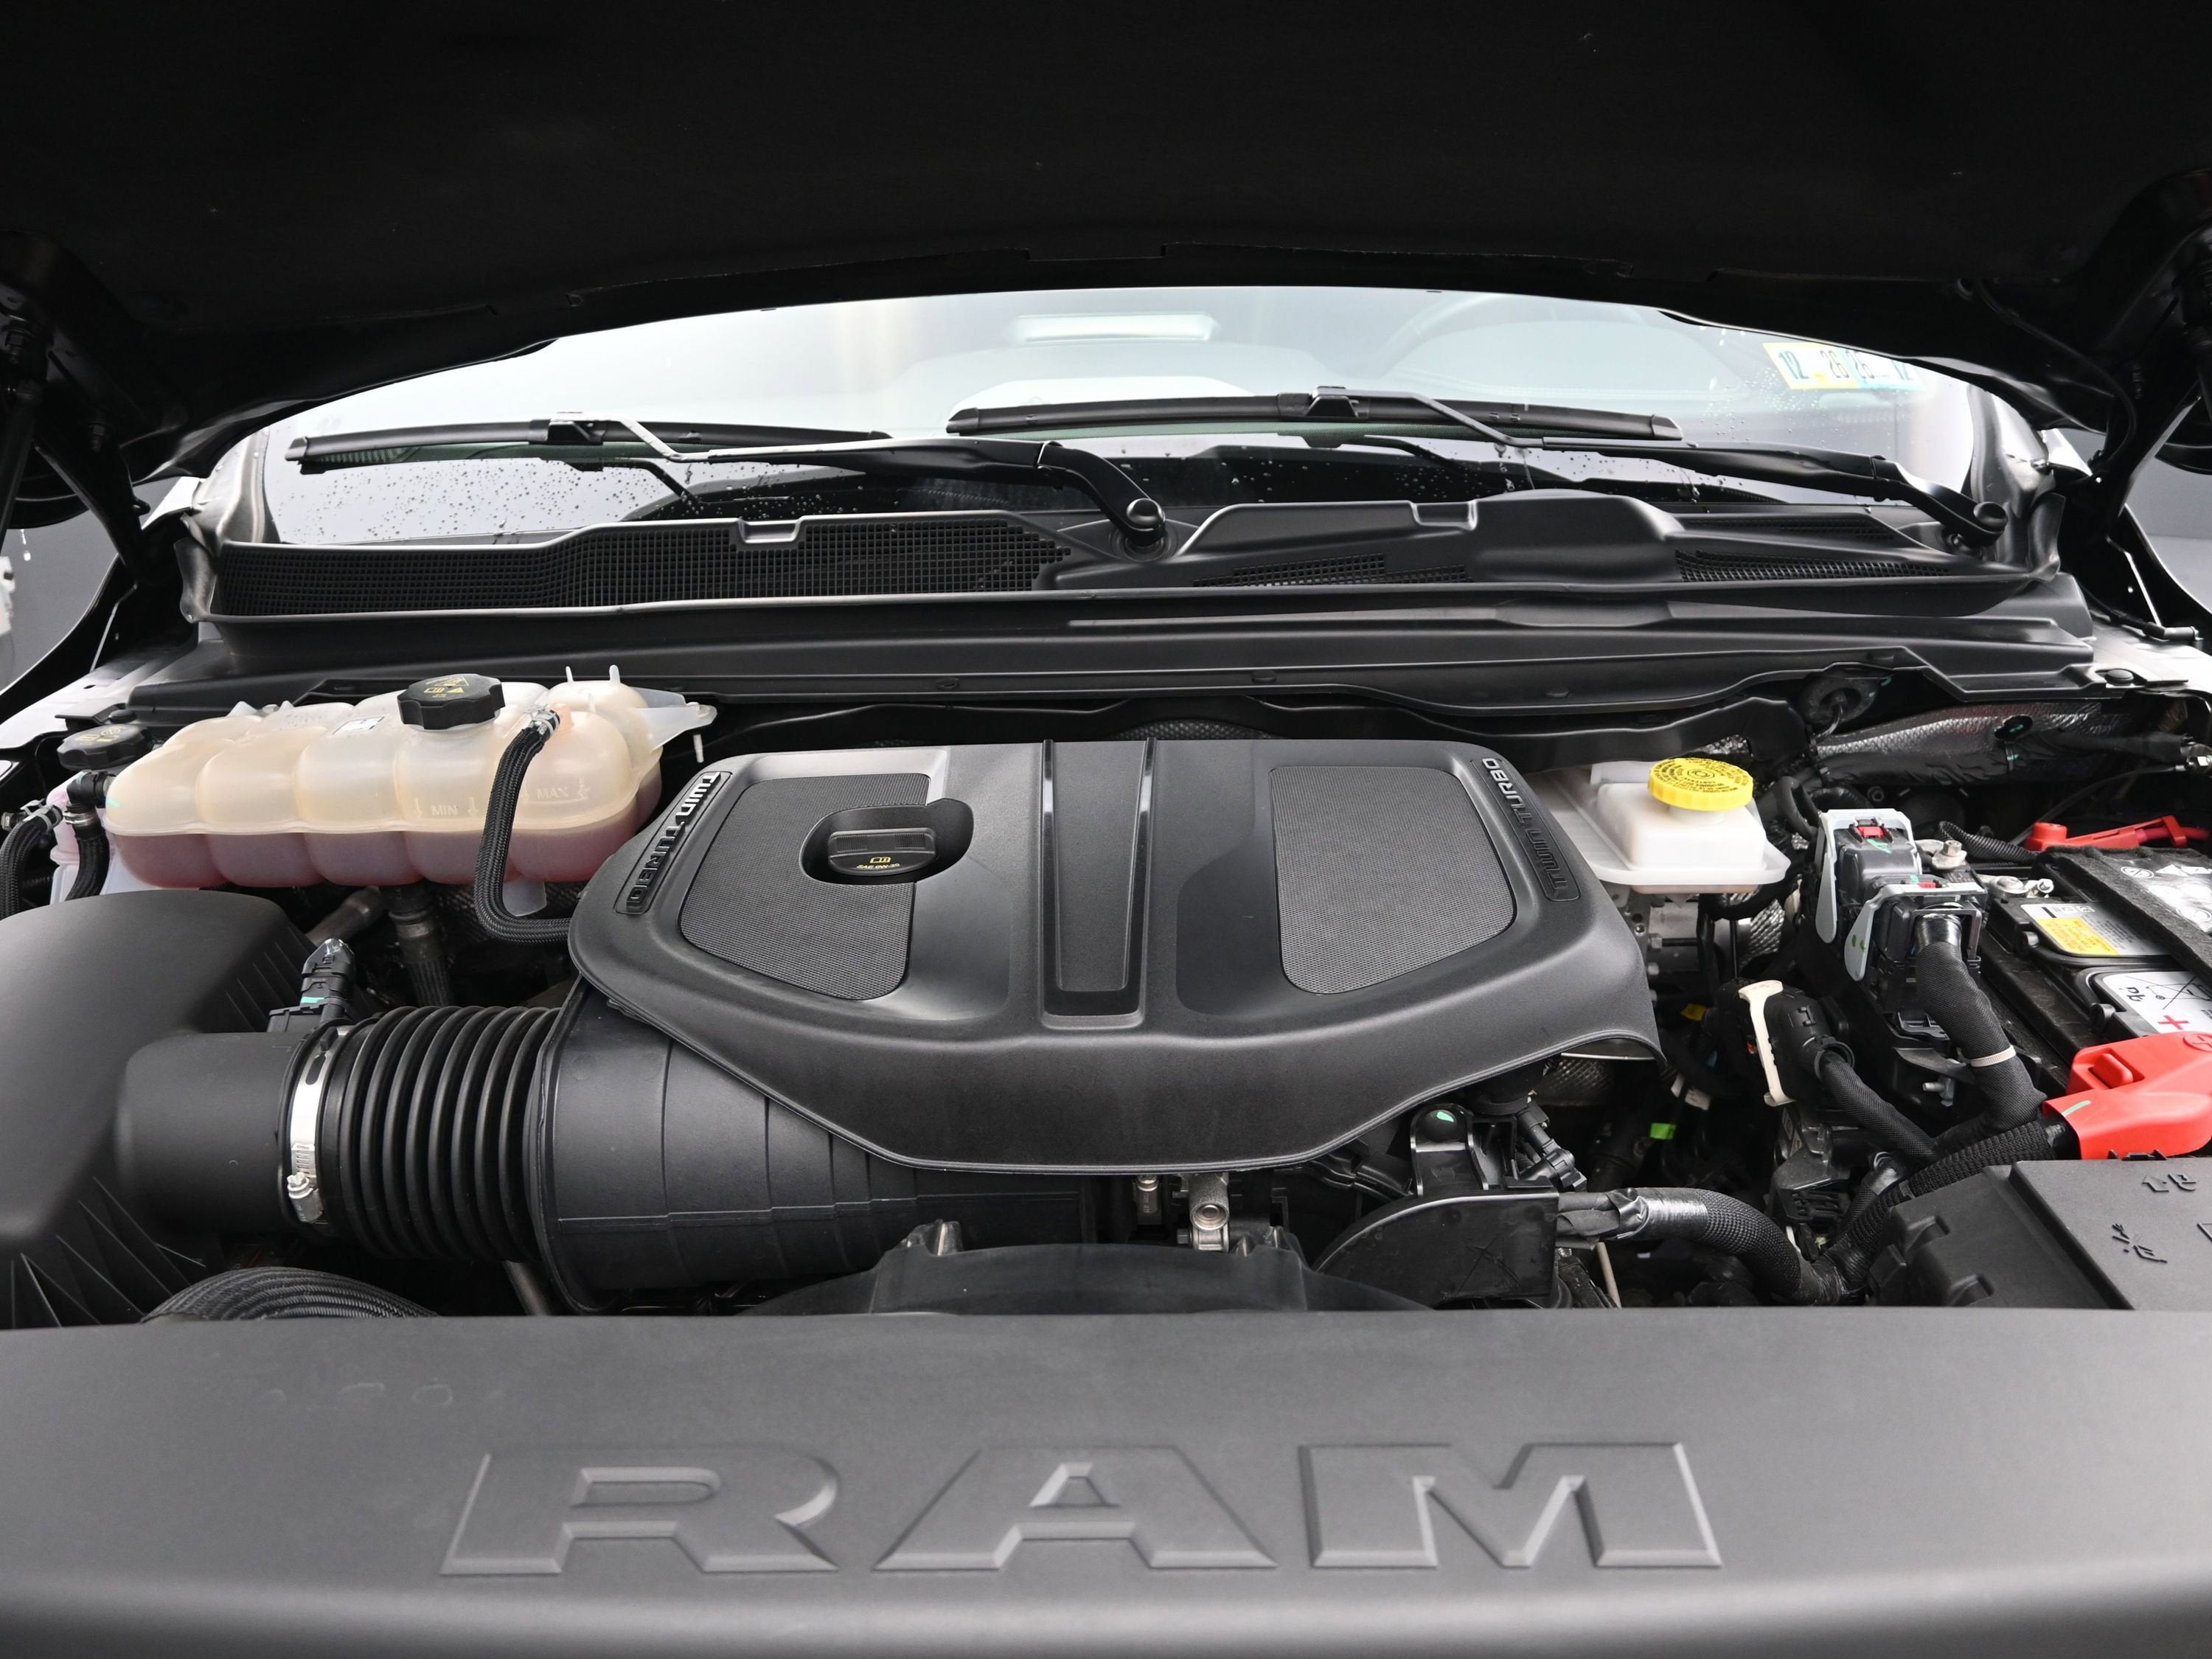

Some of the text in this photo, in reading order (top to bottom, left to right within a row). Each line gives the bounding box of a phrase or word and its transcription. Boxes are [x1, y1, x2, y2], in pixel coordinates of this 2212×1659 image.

[1778, 349, 1850, 380] 12 26
[430, 804, 458, 815] MIN
[536, 787, 570, 799] MAX
[1482, 757, 1533, 824] TURBO
[626, 771, 721, 907] TWIN TURBO
[441, 1441, 1724, 1576] RAM
